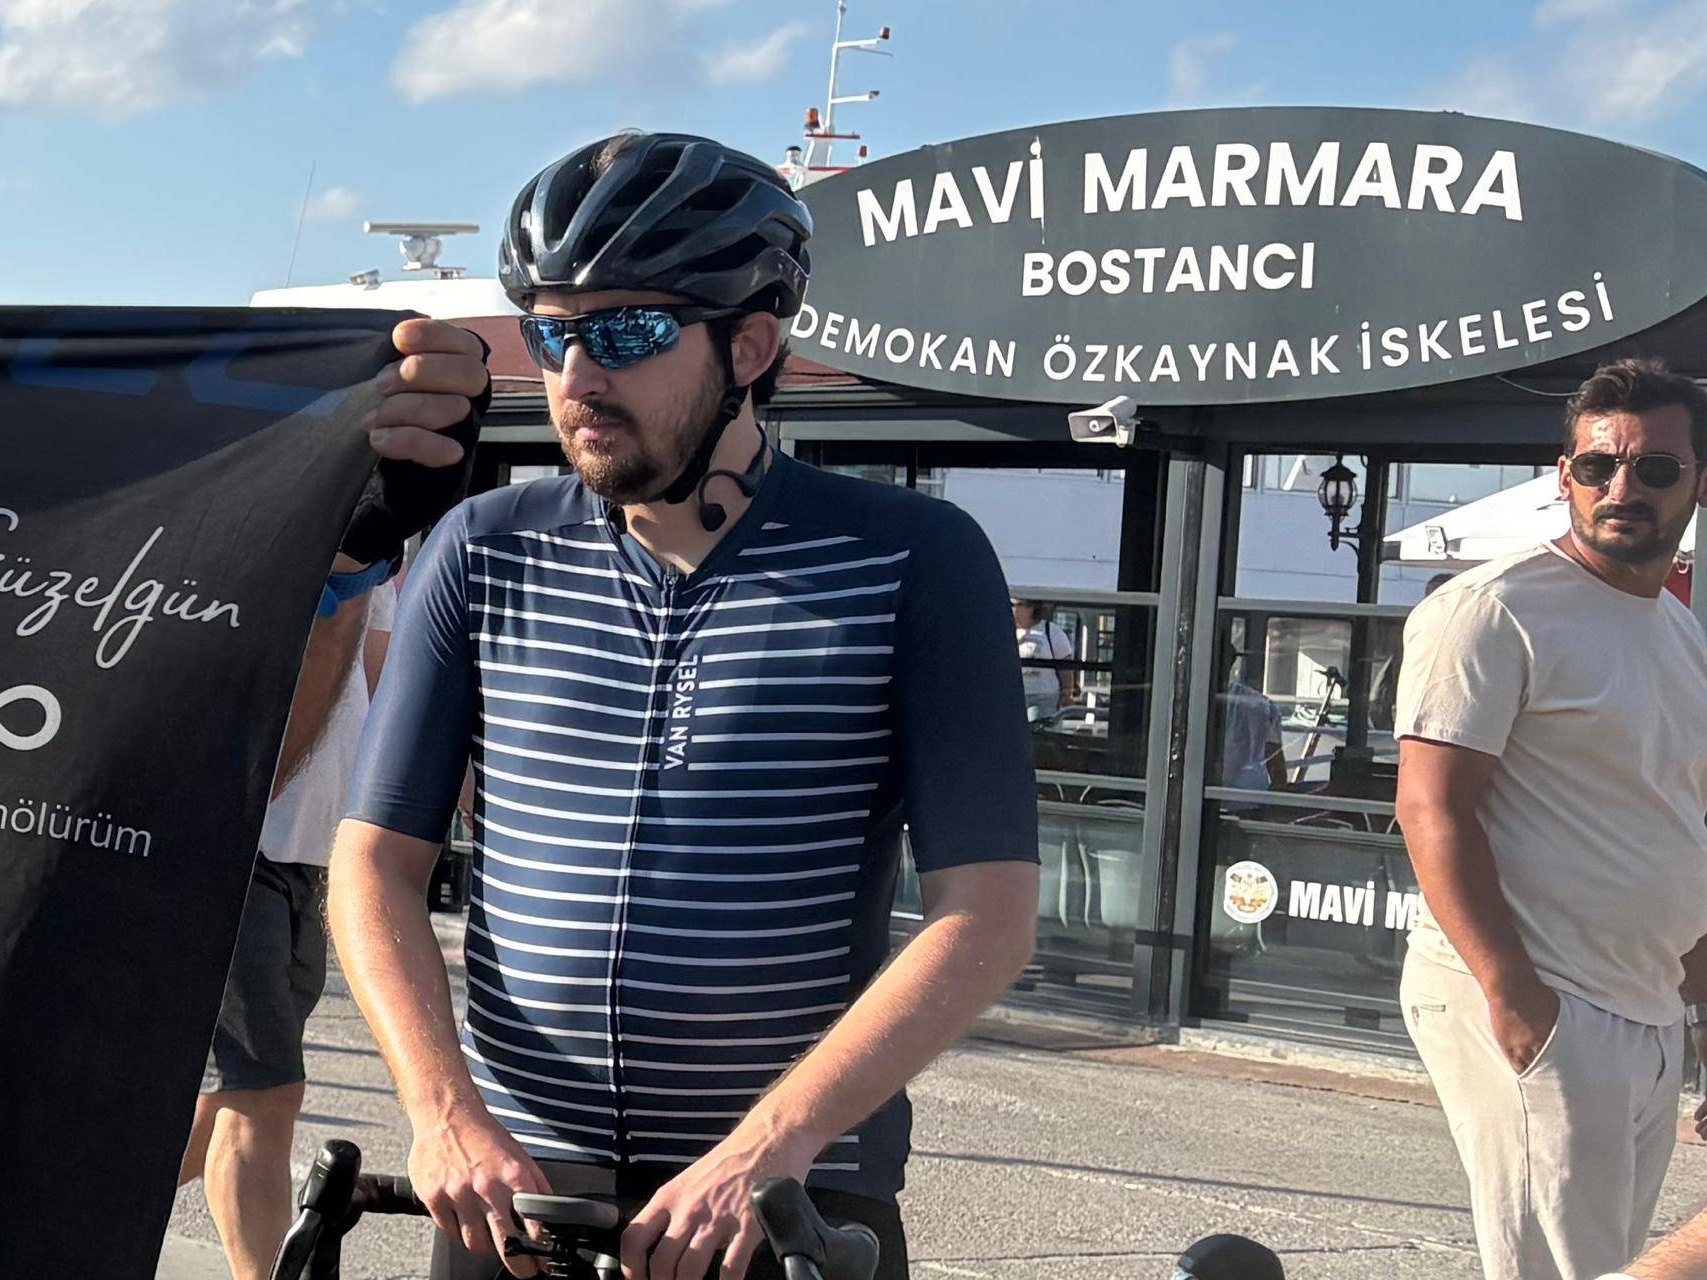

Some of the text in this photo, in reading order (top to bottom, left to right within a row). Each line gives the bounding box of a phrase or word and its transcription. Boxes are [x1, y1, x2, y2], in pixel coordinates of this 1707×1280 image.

[856, 139, 1524, 247] MAVİ MARMARA
[1022, 242, 1316, 297] BOSTANCI
[1043, 333, 1340, 384] ÖZKAYNAK
[1360, 272, 1617, 372] İSKELESİ
[663, 654, 699, 770] VAN RYSEL
[1288, 880, 1376, 926] MAVİ
